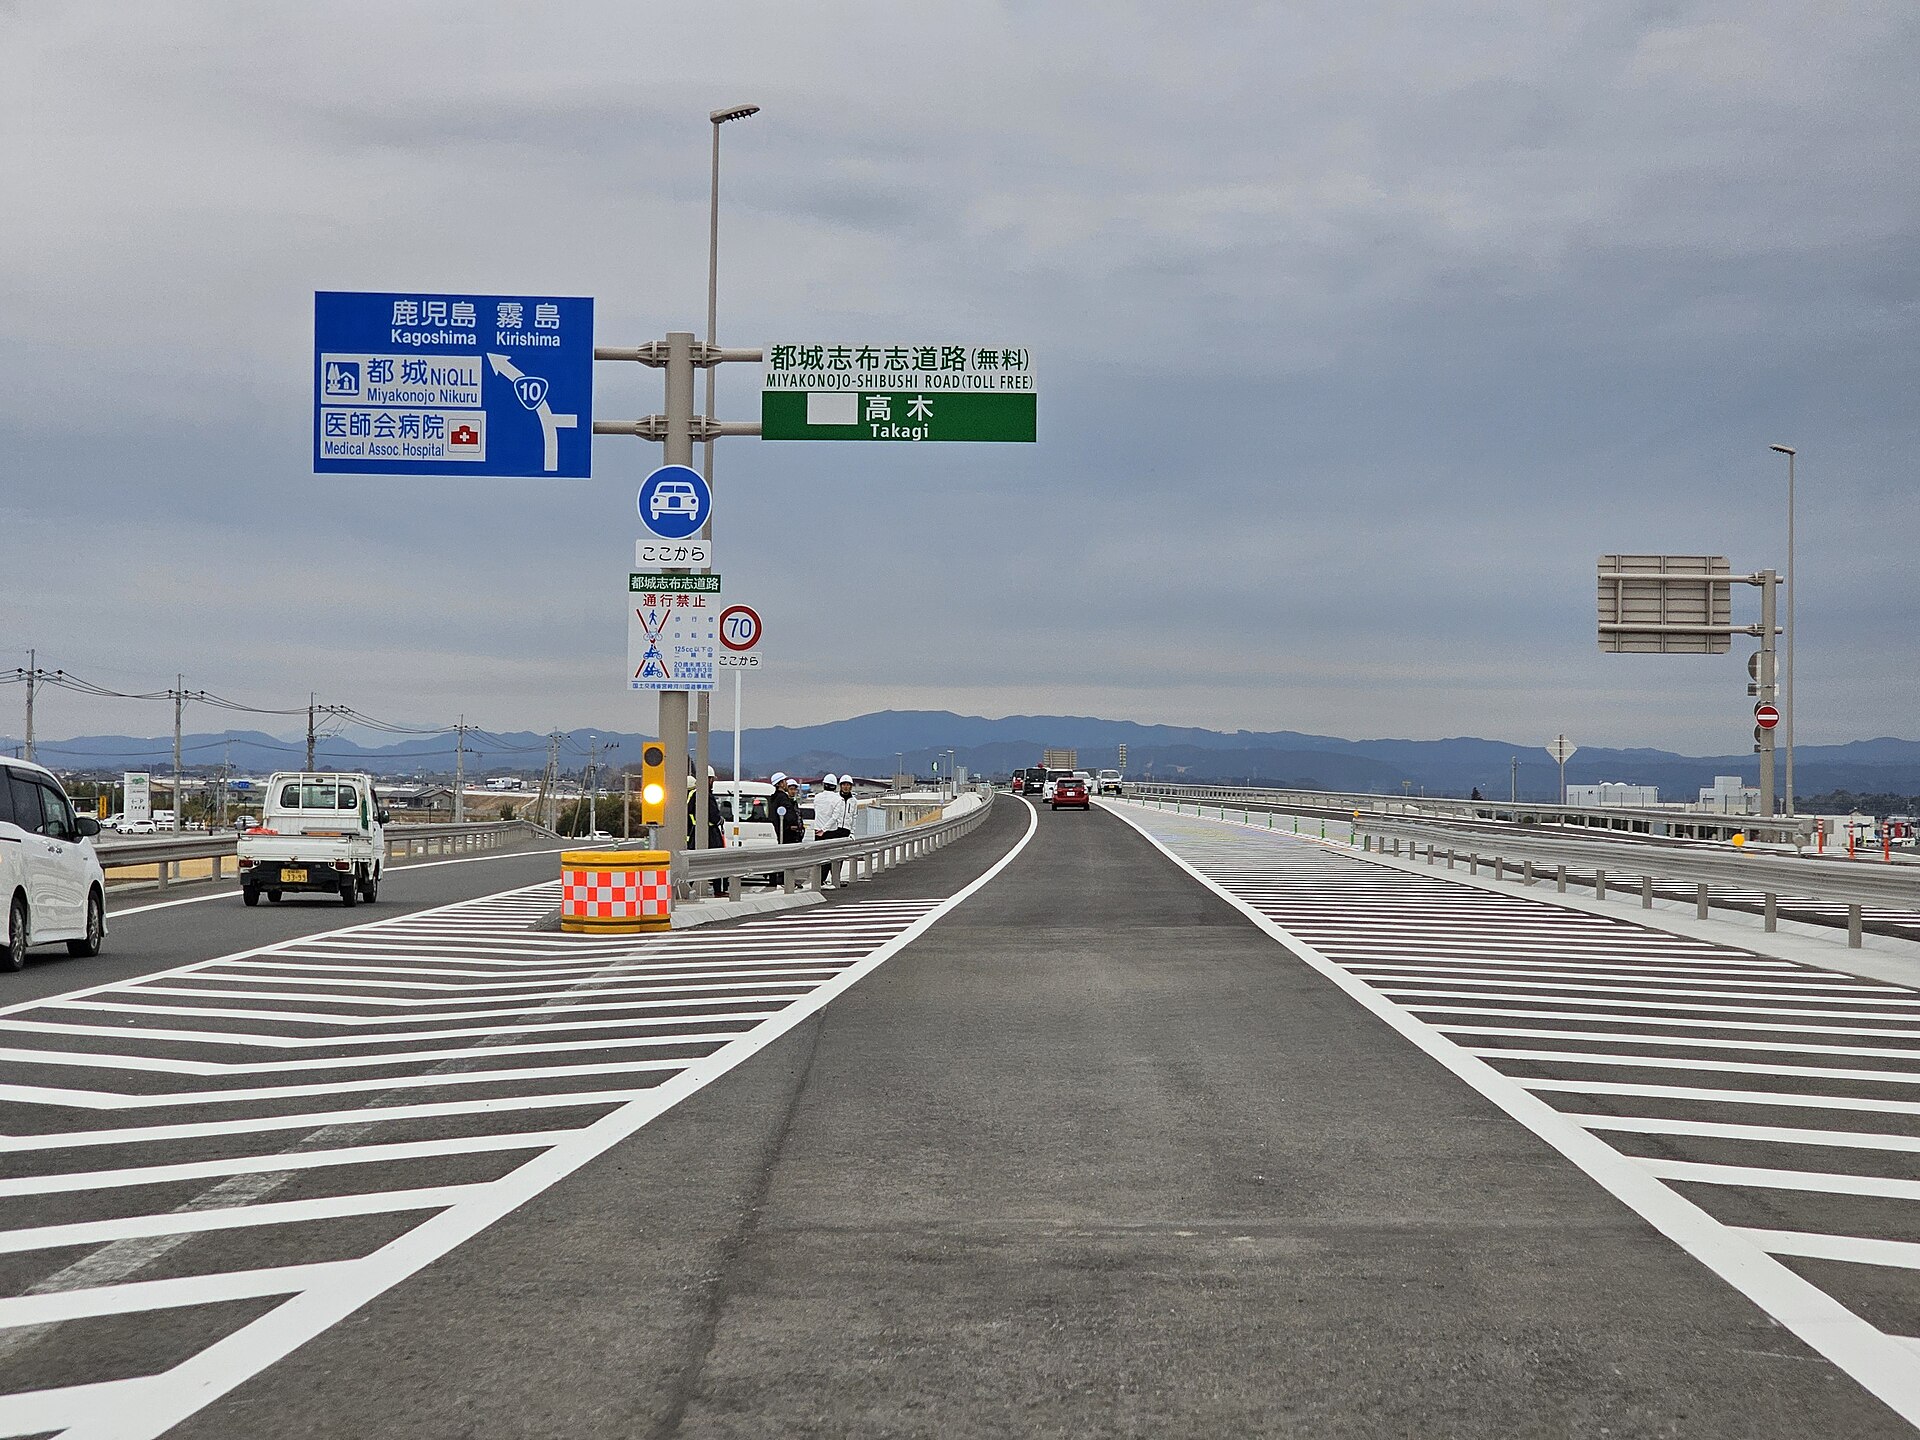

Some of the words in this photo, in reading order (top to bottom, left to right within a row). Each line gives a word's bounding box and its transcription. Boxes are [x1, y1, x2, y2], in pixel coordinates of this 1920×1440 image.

[391, 300, 476, 327] 鹿児島
[496, 302, 560, 329] 霧島
[391, 329, 476, 346] Kagoshima
[496, 331, 560, 347] Kirishima
[766, 374, 918, 389] MIYAKONOJO-SHIBUSHI
[1000, 376, 1033, 390] FREE)
[367, 388, 435, 405] Miyakonojo
[439, 389, 477, 403] Nikuru
[520, 383, 541, 400] 10
[866, 395, 934, 422] 高木
[325, 412, 444, 439] 医師会病院
[870, 423, 929, 441] Takagi
[325, 441, 364, 455] Medical
[403, 443, 444, 458] Hospital
[643, 547, 705, 561] ここから
[631, 576, 719, 591] 都城志布志道路
[643, 594, 706, 608] 通行禁止
[727, 618, 752, 638] 70
[719, 656, 759, 666] ここから
